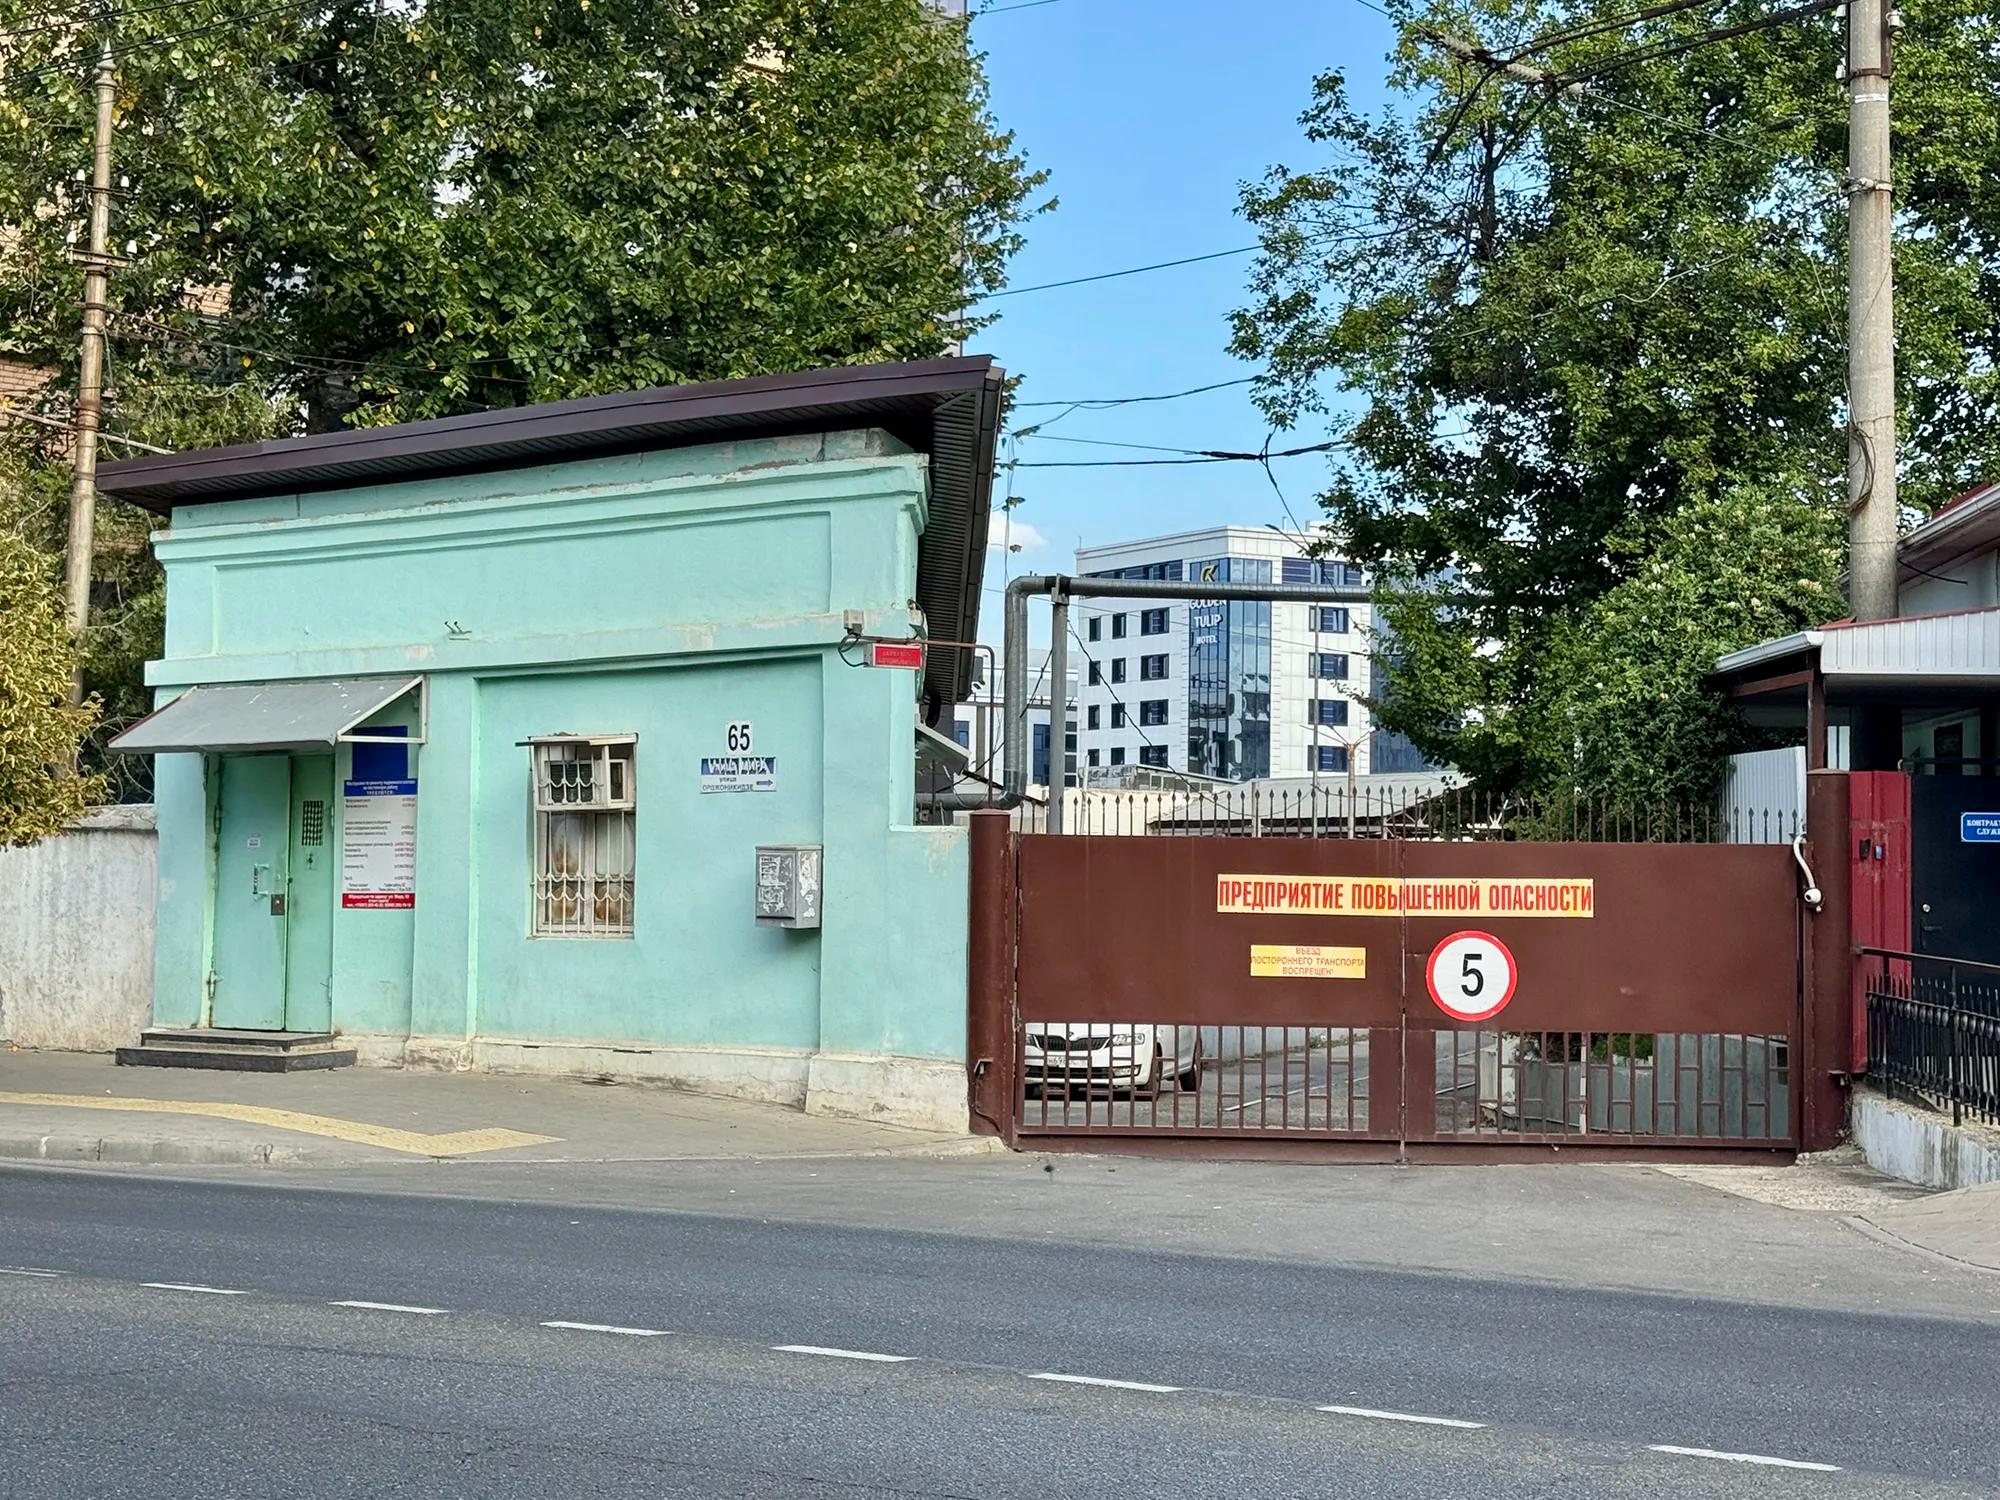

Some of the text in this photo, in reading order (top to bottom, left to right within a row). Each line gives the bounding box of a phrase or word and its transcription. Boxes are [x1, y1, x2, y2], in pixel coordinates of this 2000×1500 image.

[1194, 614, 1222, 628] TULIP
[1196, 635, 1217, 645] HOTEL
[728, 724, 750, 751] 65
[1218, 880, 1592, 912] ПРЕДПРИЯТИЕ ПОВЫШЕННОЙ ОПАСНОСТИ
[1295, 947, 1322, 956] ВЪЕЗД
[1251, 956, 1364, 966] ПОСТОРОННЕГО ТРАНСПОРТА
[1461, 953, 1484, 997] 5
